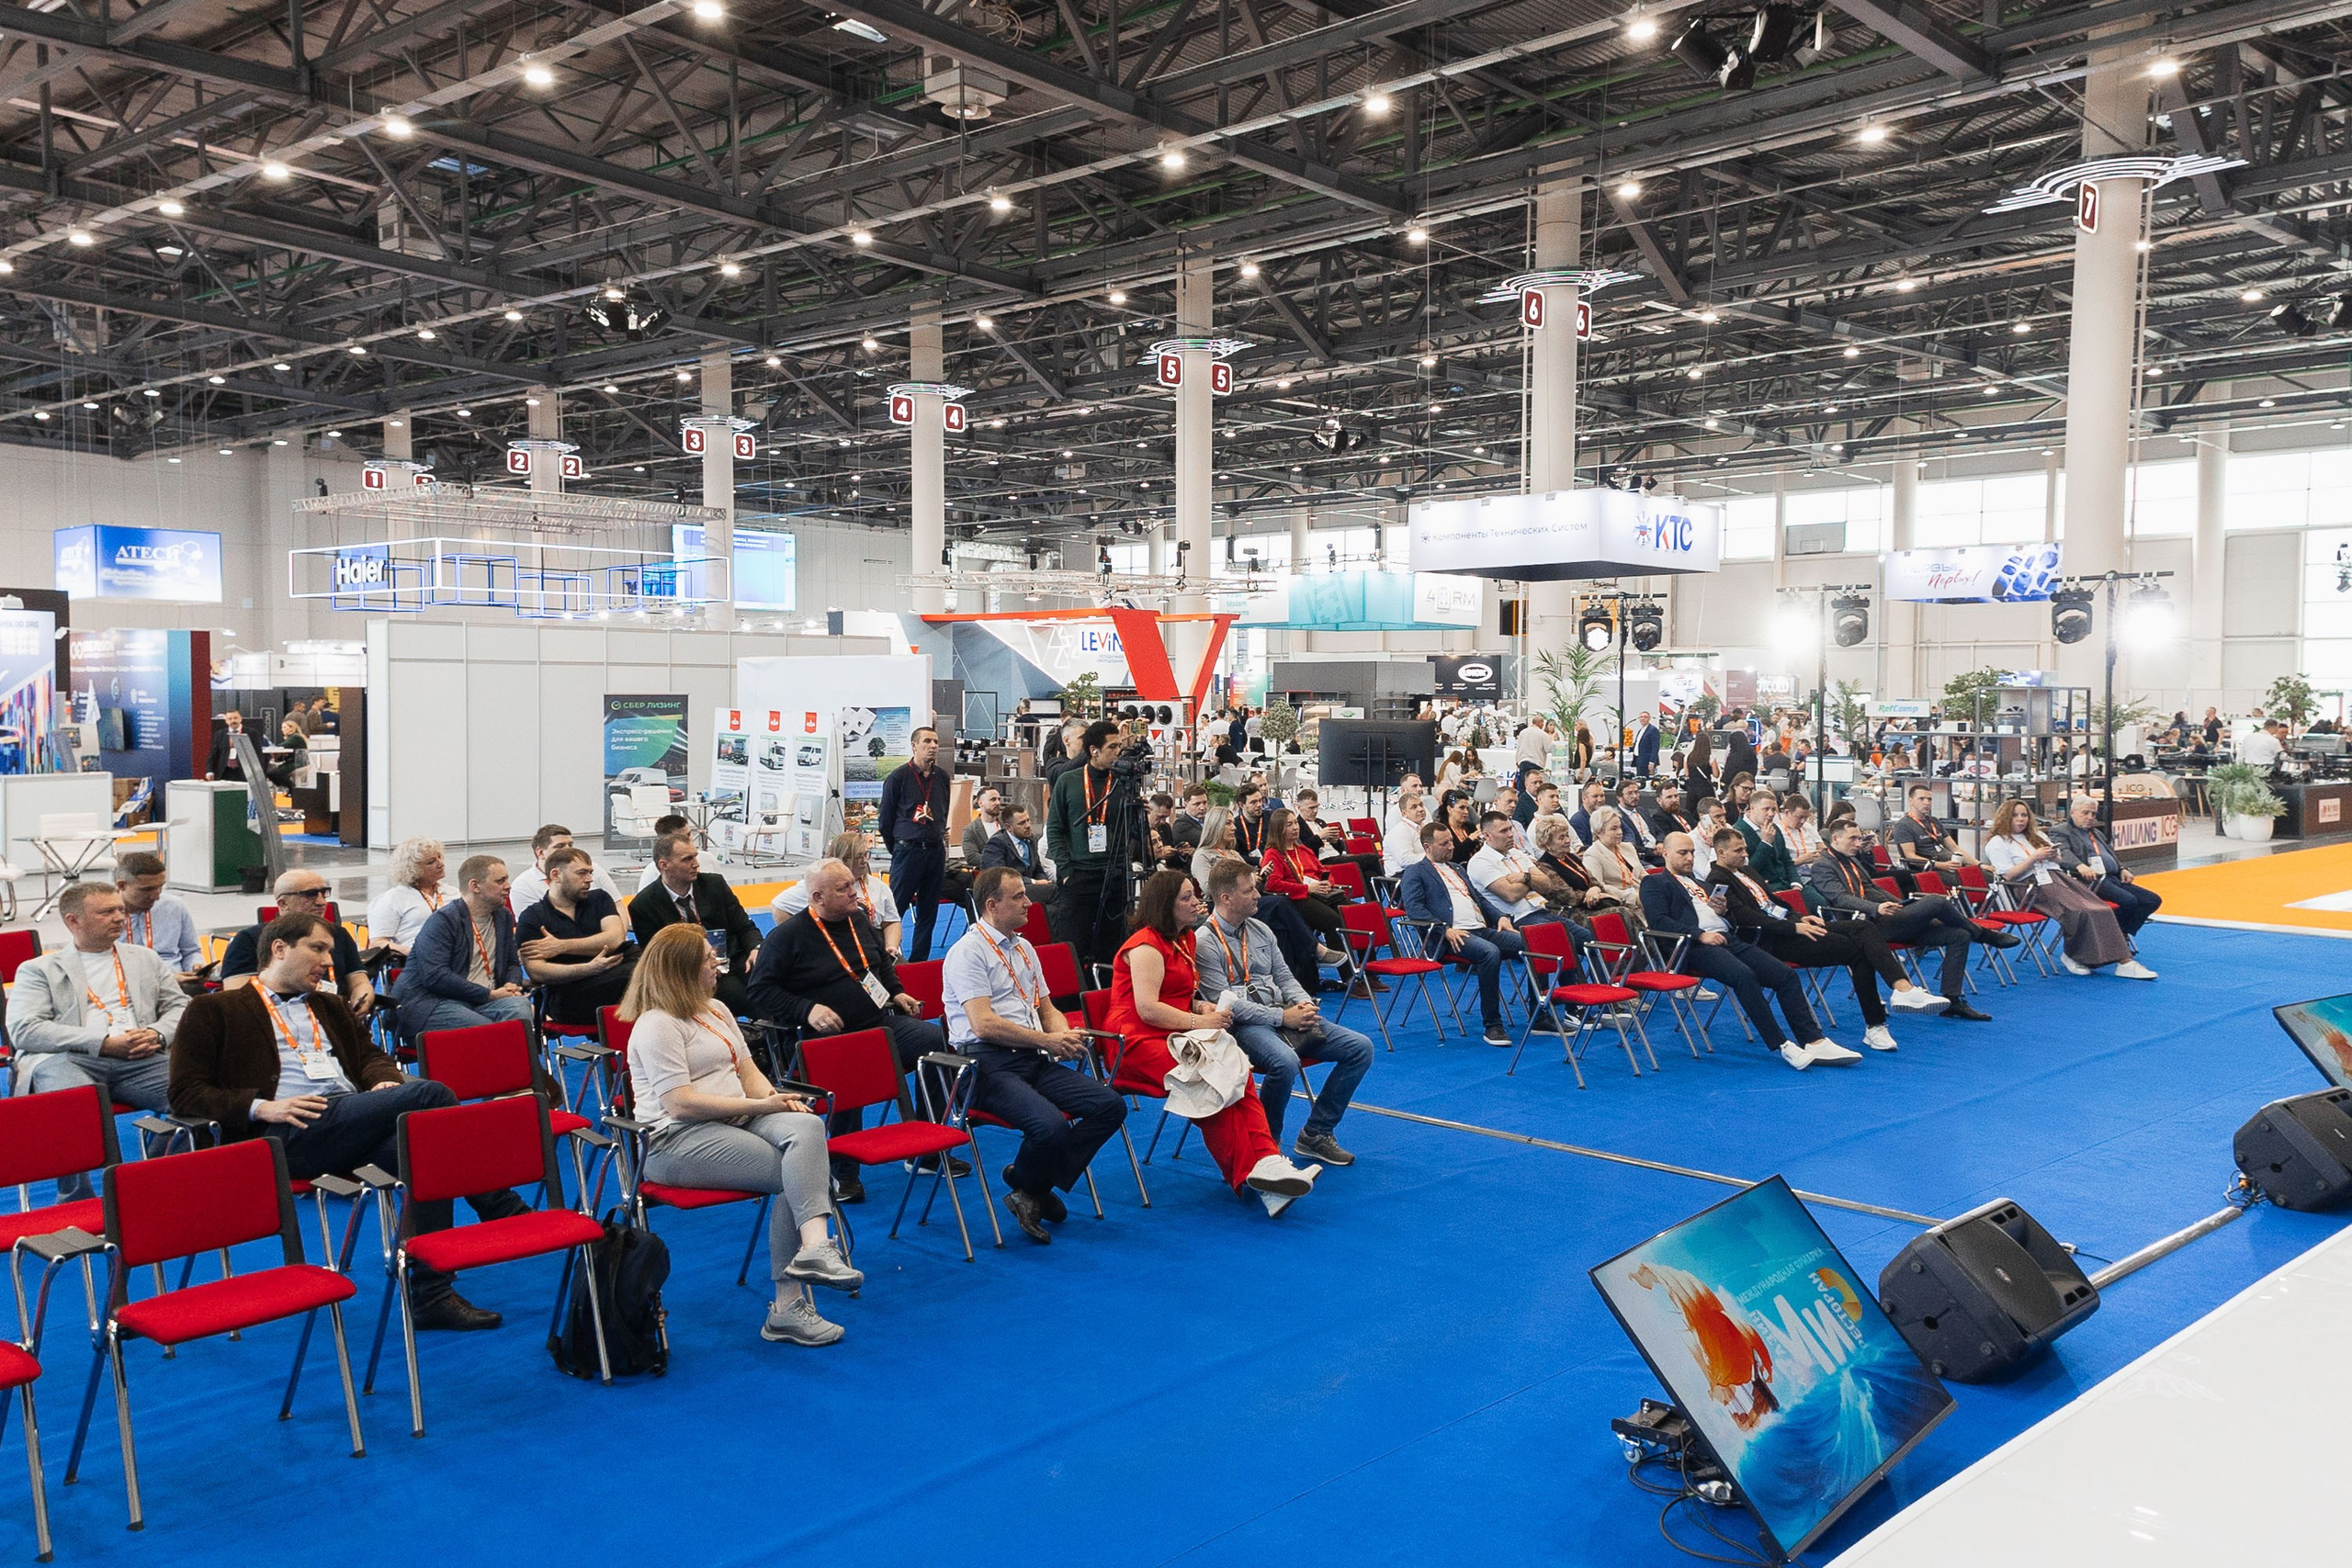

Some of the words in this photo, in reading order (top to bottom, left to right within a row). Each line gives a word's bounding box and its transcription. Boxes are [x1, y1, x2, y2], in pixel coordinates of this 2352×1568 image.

[2085, 191, 2095, 220] 7
[1529, 298, 1539, 321] 6
[1577, 309, 1586, 332] 6
[1166, 359, 1177, 379] 5
[1216, 368, 1227, 389] 5
[897, 401, 908, 419] 4
[949, 410, 959, 426] 4
[689, 433, 701, 449] 3
[740, 438, 750, 455] 3
[514, 454, 526, 469] 2
[566, 460, 576, 474] 2
[370, 472, 379, 487] 1
[1432, 531, 1487, 542] Компоненты
[1490, 525, 1549, 537] Технических
[1551, 522, 1588, 533] Систем
[336, 555, 385, 585] Haier
[1878, 704, 1919, 714] RefComp
[611, 728, 673, 736] Экспресс-решения
[2126, 784, 2145, 792] ICG
[2113, 821, 2157, 847] HAILIANG
[2161, 816, 2177, 838] ICG
[1736, 1261, 1796, 1305] МЕЖДУНАРОДНАЯ
[1794, 1247, 1826, 1271] ЯРМАРКА
[1808, 1271, 1870, 1349] РЕСТОРАН
